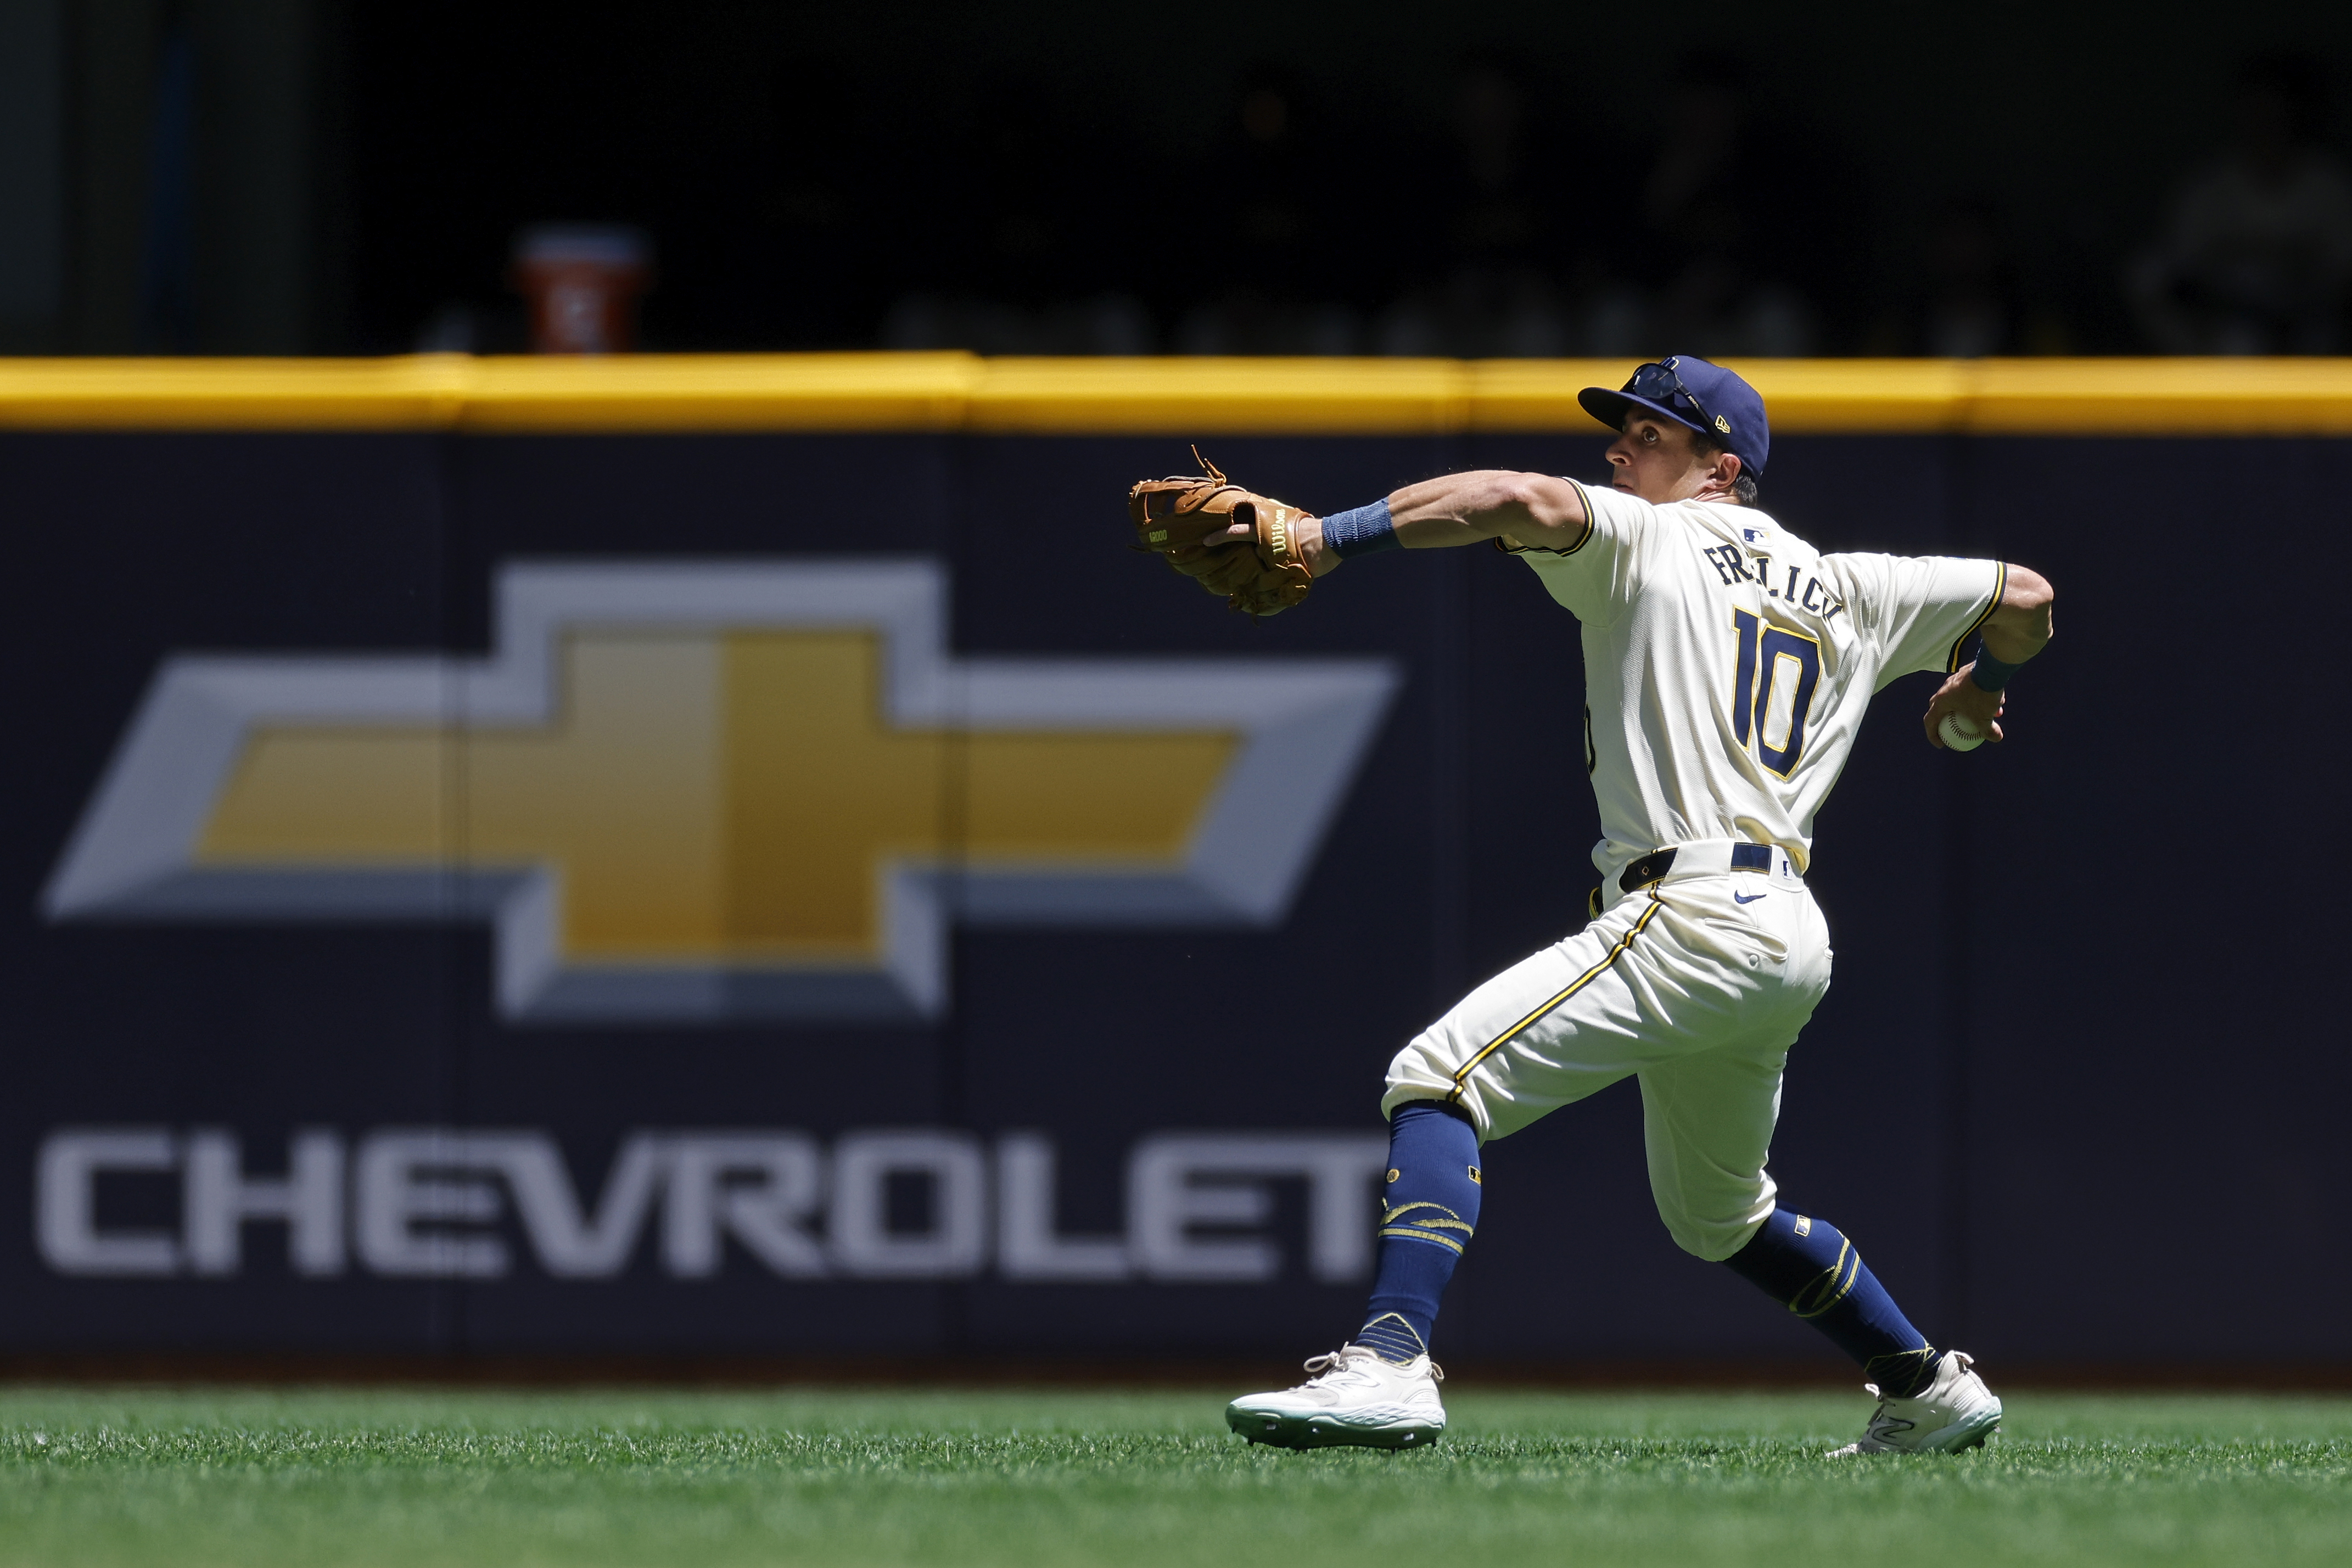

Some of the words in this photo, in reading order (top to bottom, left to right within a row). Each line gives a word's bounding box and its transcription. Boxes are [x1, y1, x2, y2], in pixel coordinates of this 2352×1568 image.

[1272, 508, 1286, 555] Wilson
[1703, 544, 1843, 620] FRLIC
[1732, 604, 1823, 781] 10
[35, 1129, 1390, 1279] CHEVROLET
